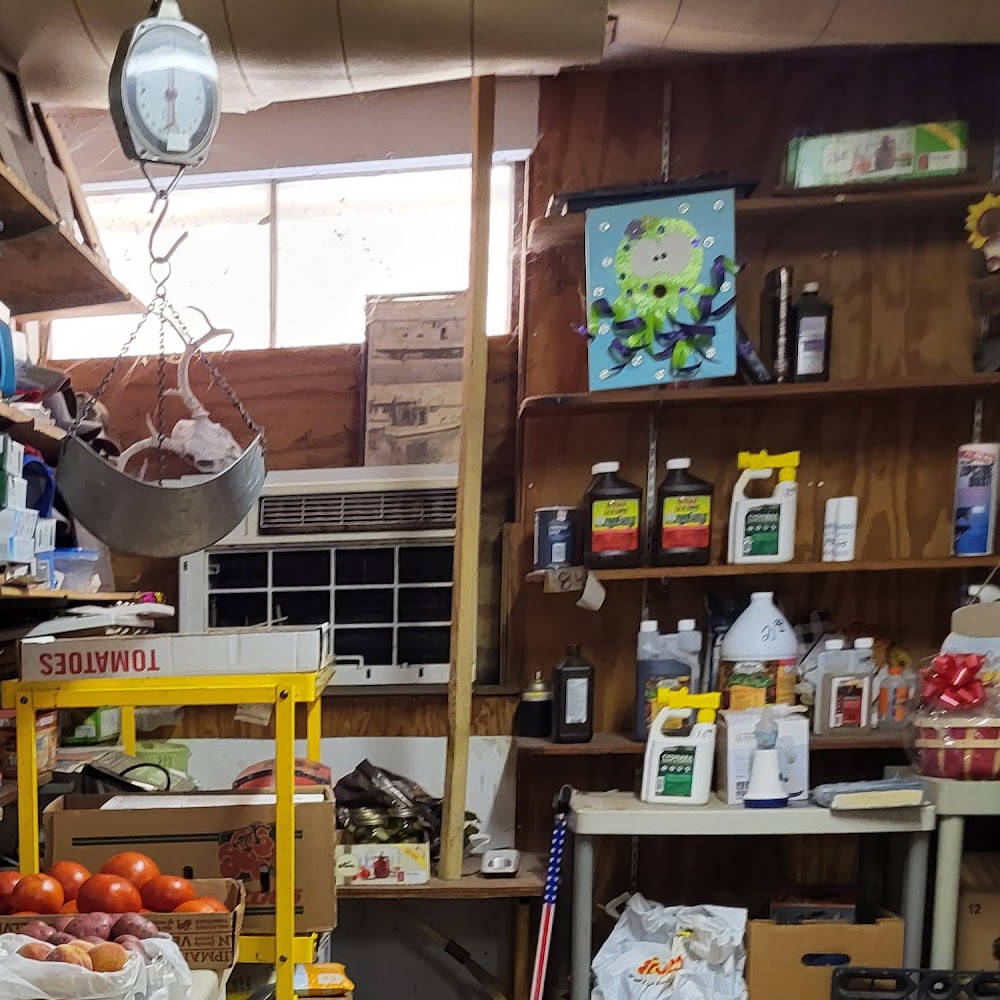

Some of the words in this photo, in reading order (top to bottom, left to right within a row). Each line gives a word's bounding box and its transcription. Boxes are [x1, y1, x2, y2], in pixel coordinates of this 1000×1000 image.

[38, 649, 160, 676] TOMATOES
[968, 903, 981, 914] 12
[185, 951, 234, 963] IPMA
